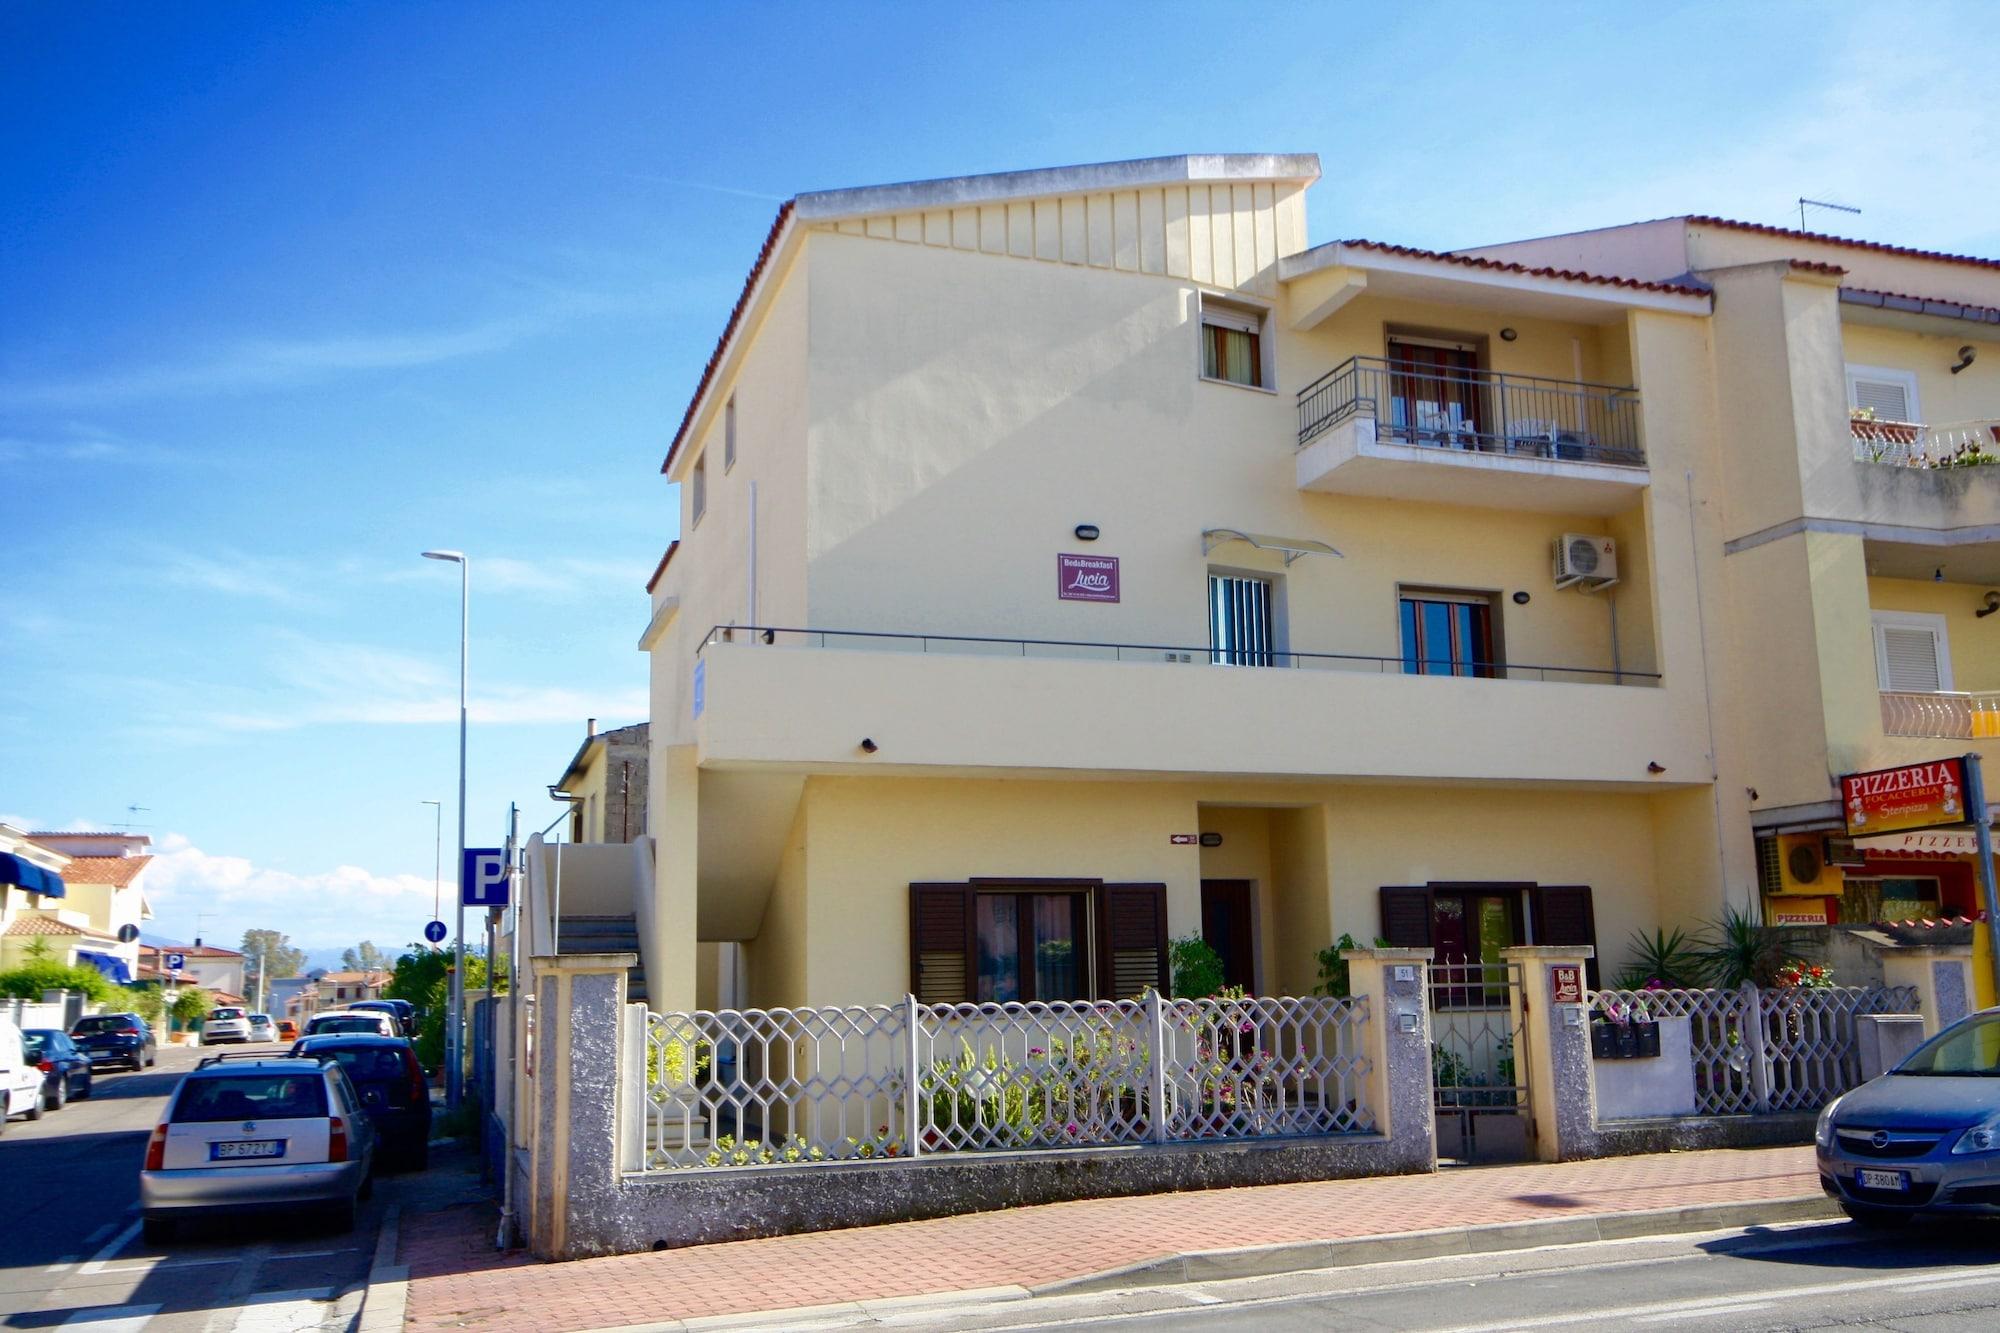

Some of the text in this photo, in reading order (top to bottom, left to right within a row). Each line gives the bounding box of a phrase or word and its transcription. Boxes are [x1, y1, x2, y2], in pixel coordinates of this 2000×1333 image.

[1068, 570, 1110, 591] Lucia
[1849, 763, 1954, 797] PIZZERIA
[1865, 786, 1939, 804] FOCACCERIA
[475, 855, 506, 899] P
[1777, 914, 1825, 922] PIZZERIA
[168, 955, 181, 968] P
[1558, 970, 1575, 980] B&B
